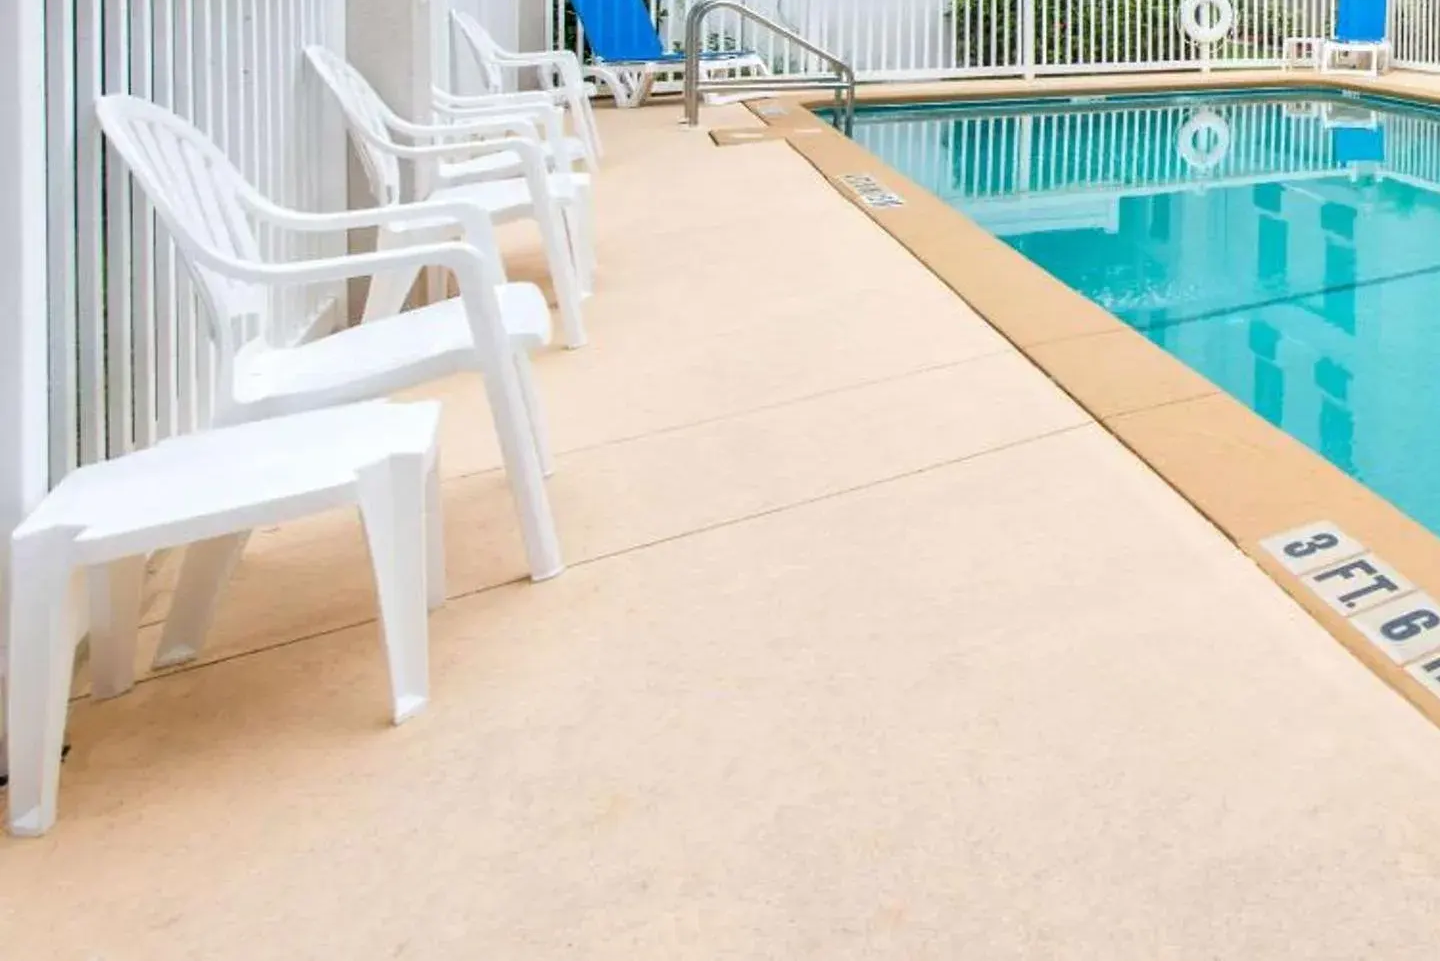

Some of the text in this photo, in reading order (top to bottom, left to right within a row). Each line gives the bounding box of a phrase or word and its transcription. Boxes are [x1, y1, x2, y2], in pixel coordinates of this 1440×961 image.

[1284, 533, 1339, 558] 3
[1313, 559, 1399, 608] FT.
[1380, 609, 1440, 641] 6
